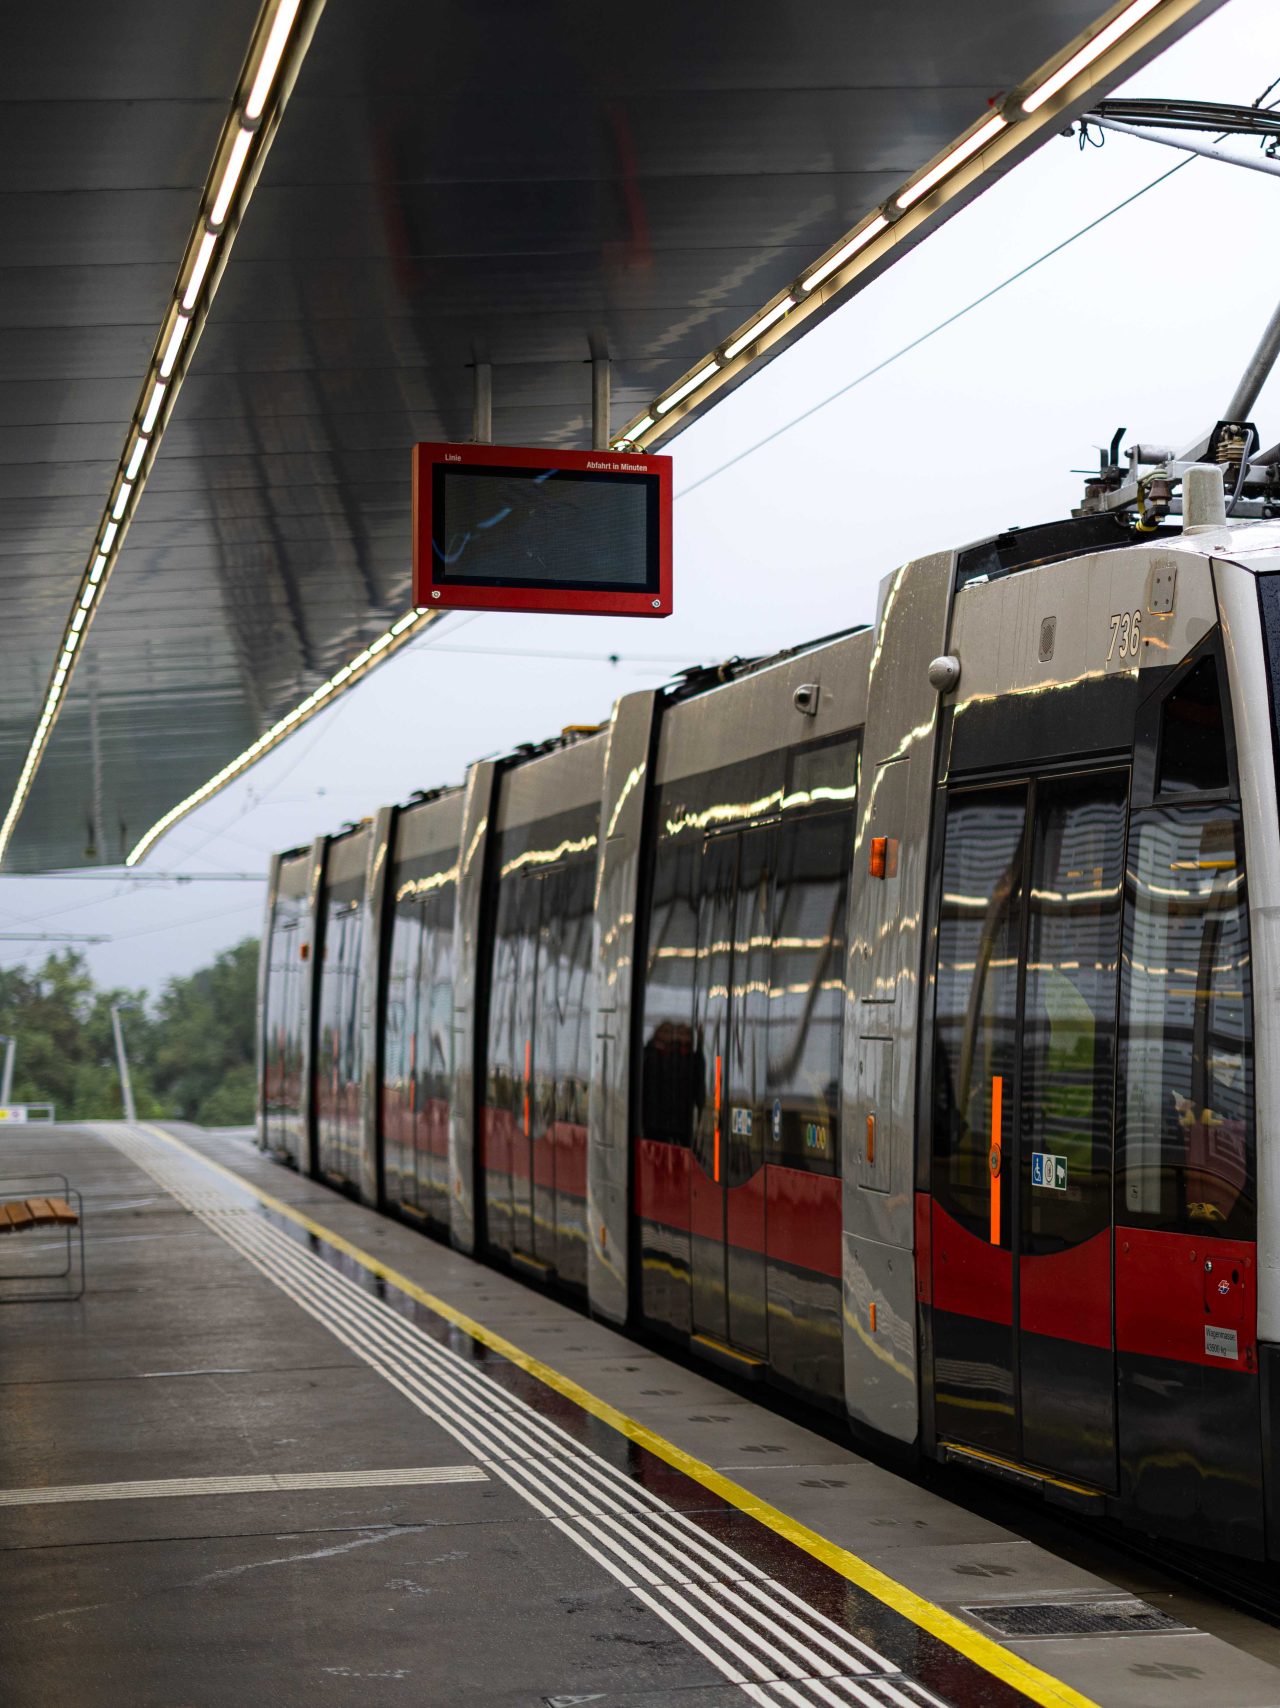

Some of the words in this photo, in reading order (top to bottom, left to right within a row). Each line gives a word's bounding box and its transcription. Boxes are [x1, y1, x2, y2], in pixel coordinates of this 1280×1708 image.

[445, 453, 462, 462] Linie
[586, 461, 611, 470] Abfahrt
[612, 462, 620, 470] in
[620, 463, 648, 472] Minuten
[1106, 609, 1142, 661] 736
